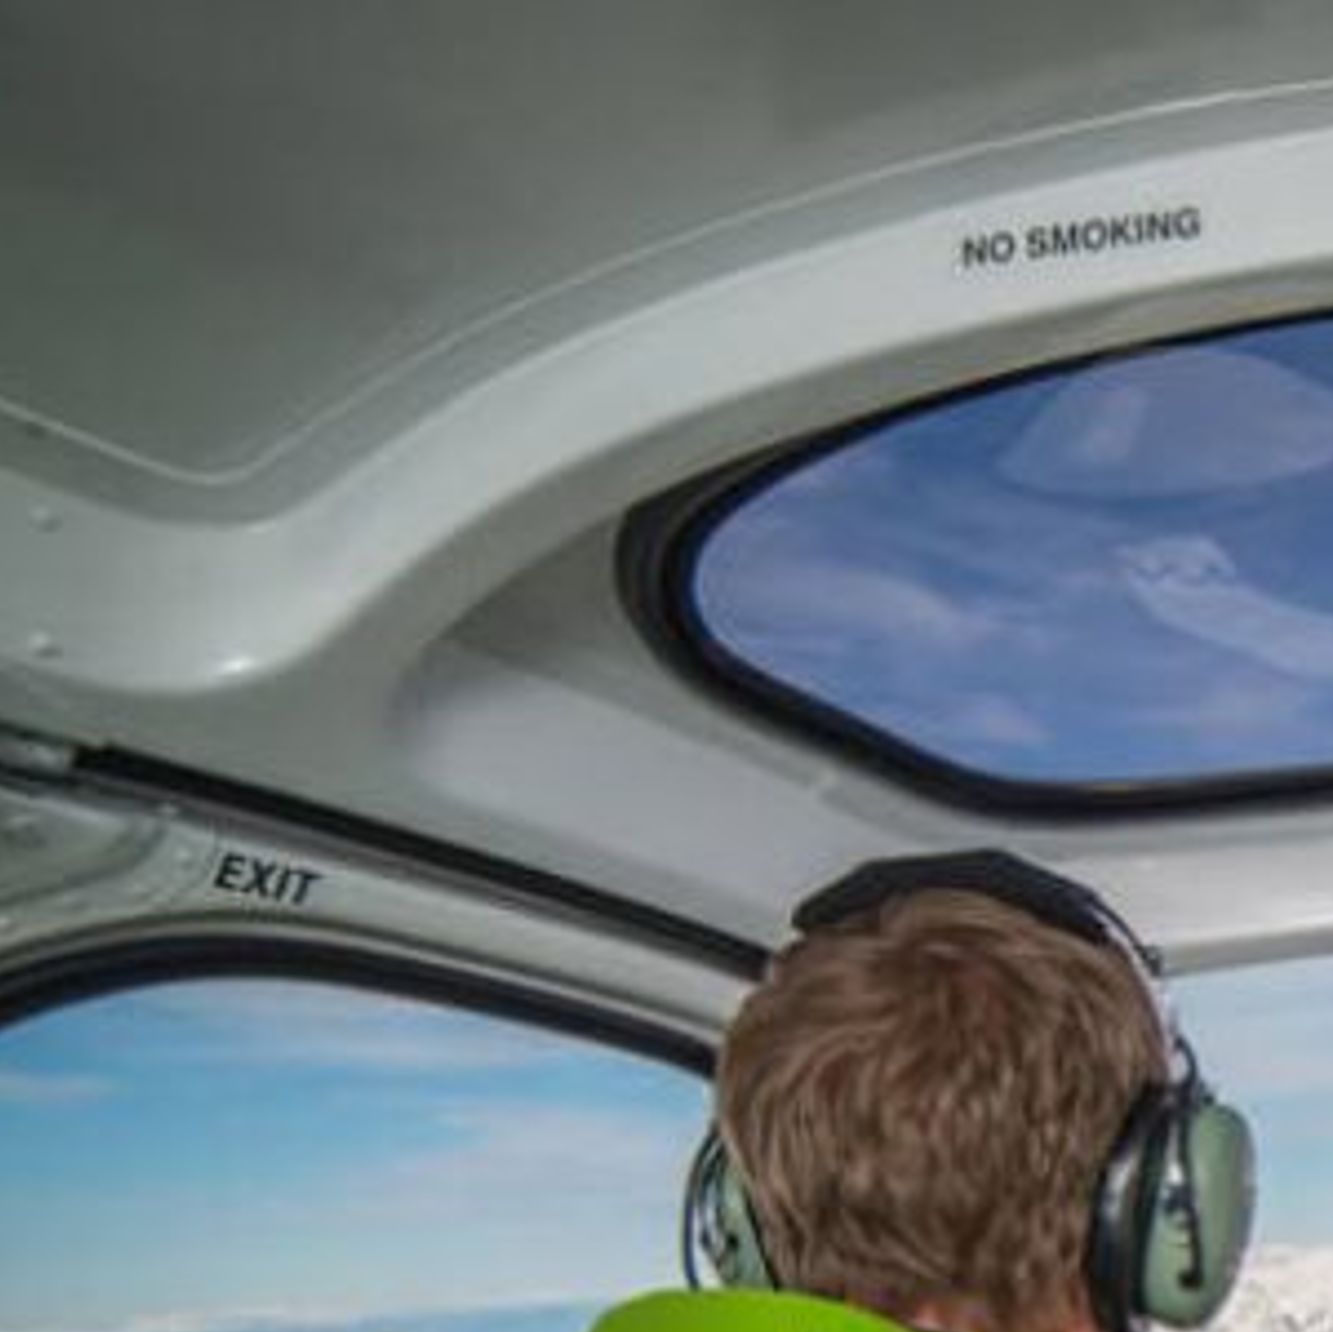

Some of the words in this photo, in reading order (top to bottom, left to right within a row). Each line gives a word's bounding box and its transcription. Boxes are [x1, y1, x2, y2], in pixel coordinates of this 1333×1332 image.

[962, 231, 1015, 267] NO
[1026, 207, 1201, 258] SMOKING
[214, 853, 325, 905] EXIT
